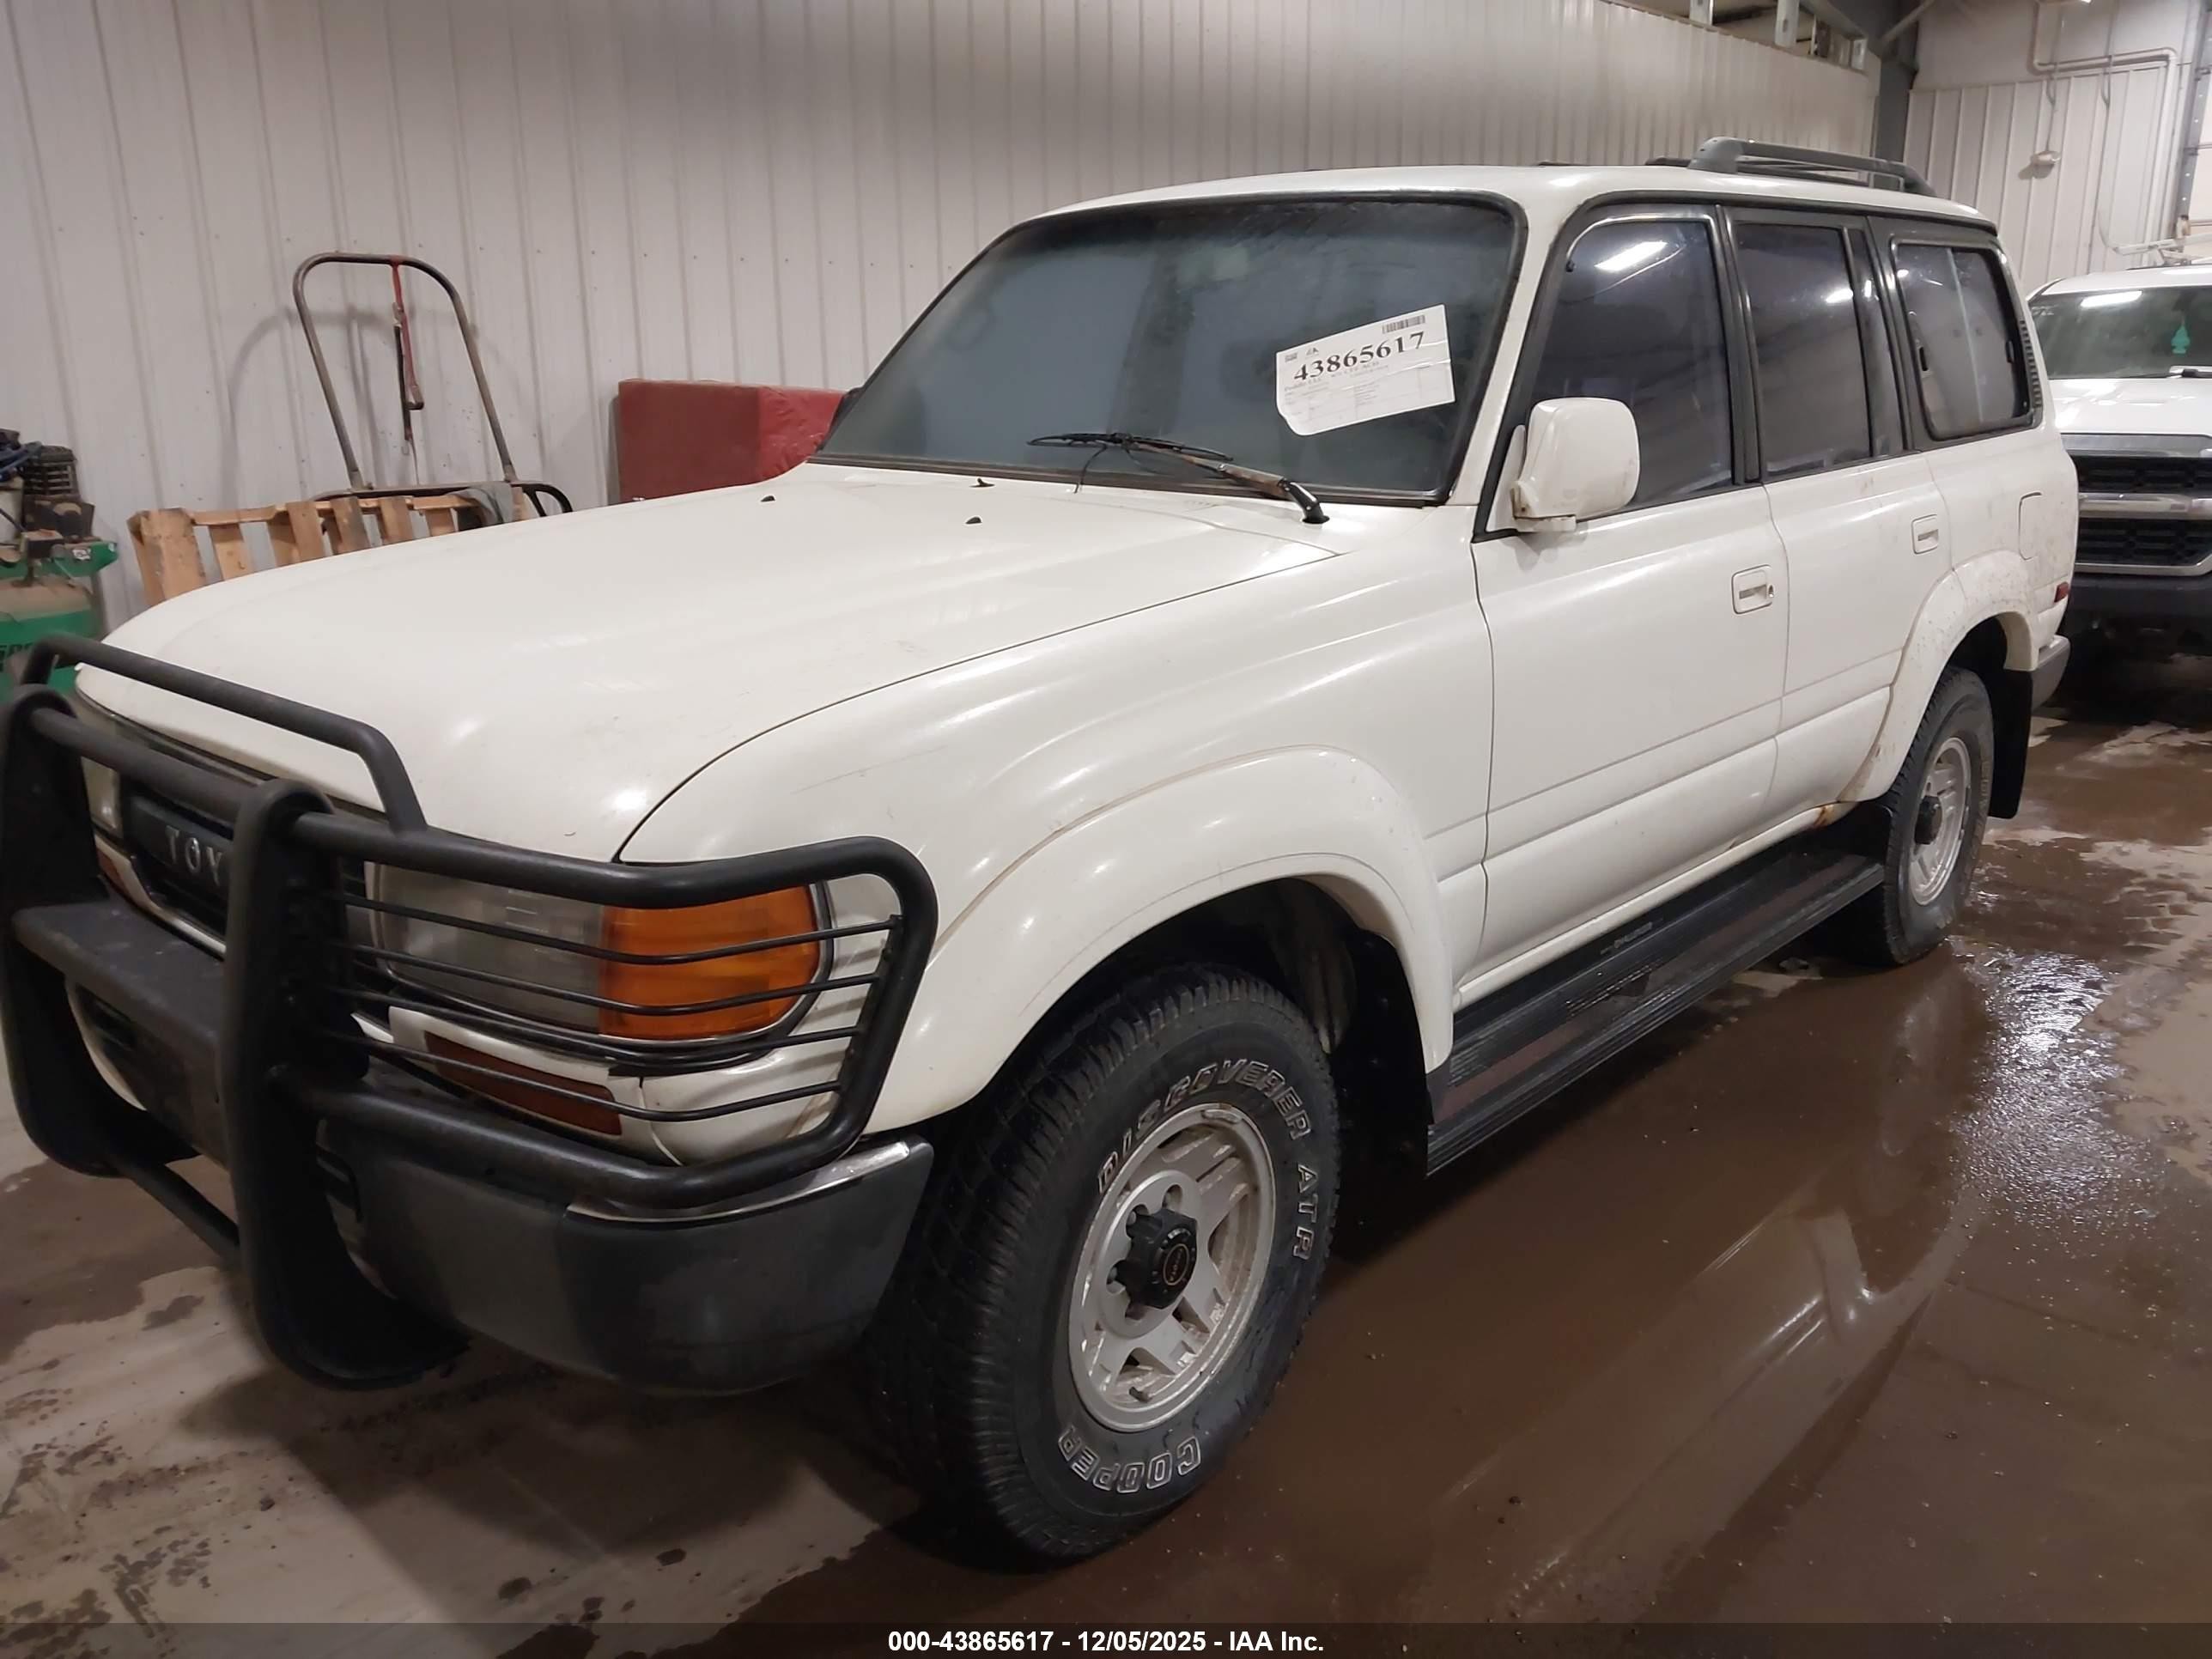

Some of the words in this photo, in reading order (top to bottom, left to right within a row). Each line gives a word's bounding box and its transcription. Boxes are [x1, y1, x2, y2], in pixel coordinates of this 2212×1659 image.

[1293, 331, 1425, 380] 43865617
[165, 825, 223, 885] TOY
[1098, 1059, 1311, 1194] DISCOVERER
[1293, 1164, 1318, 1261] ATR
[1058, 1425, 1201, 1493] COOPER
